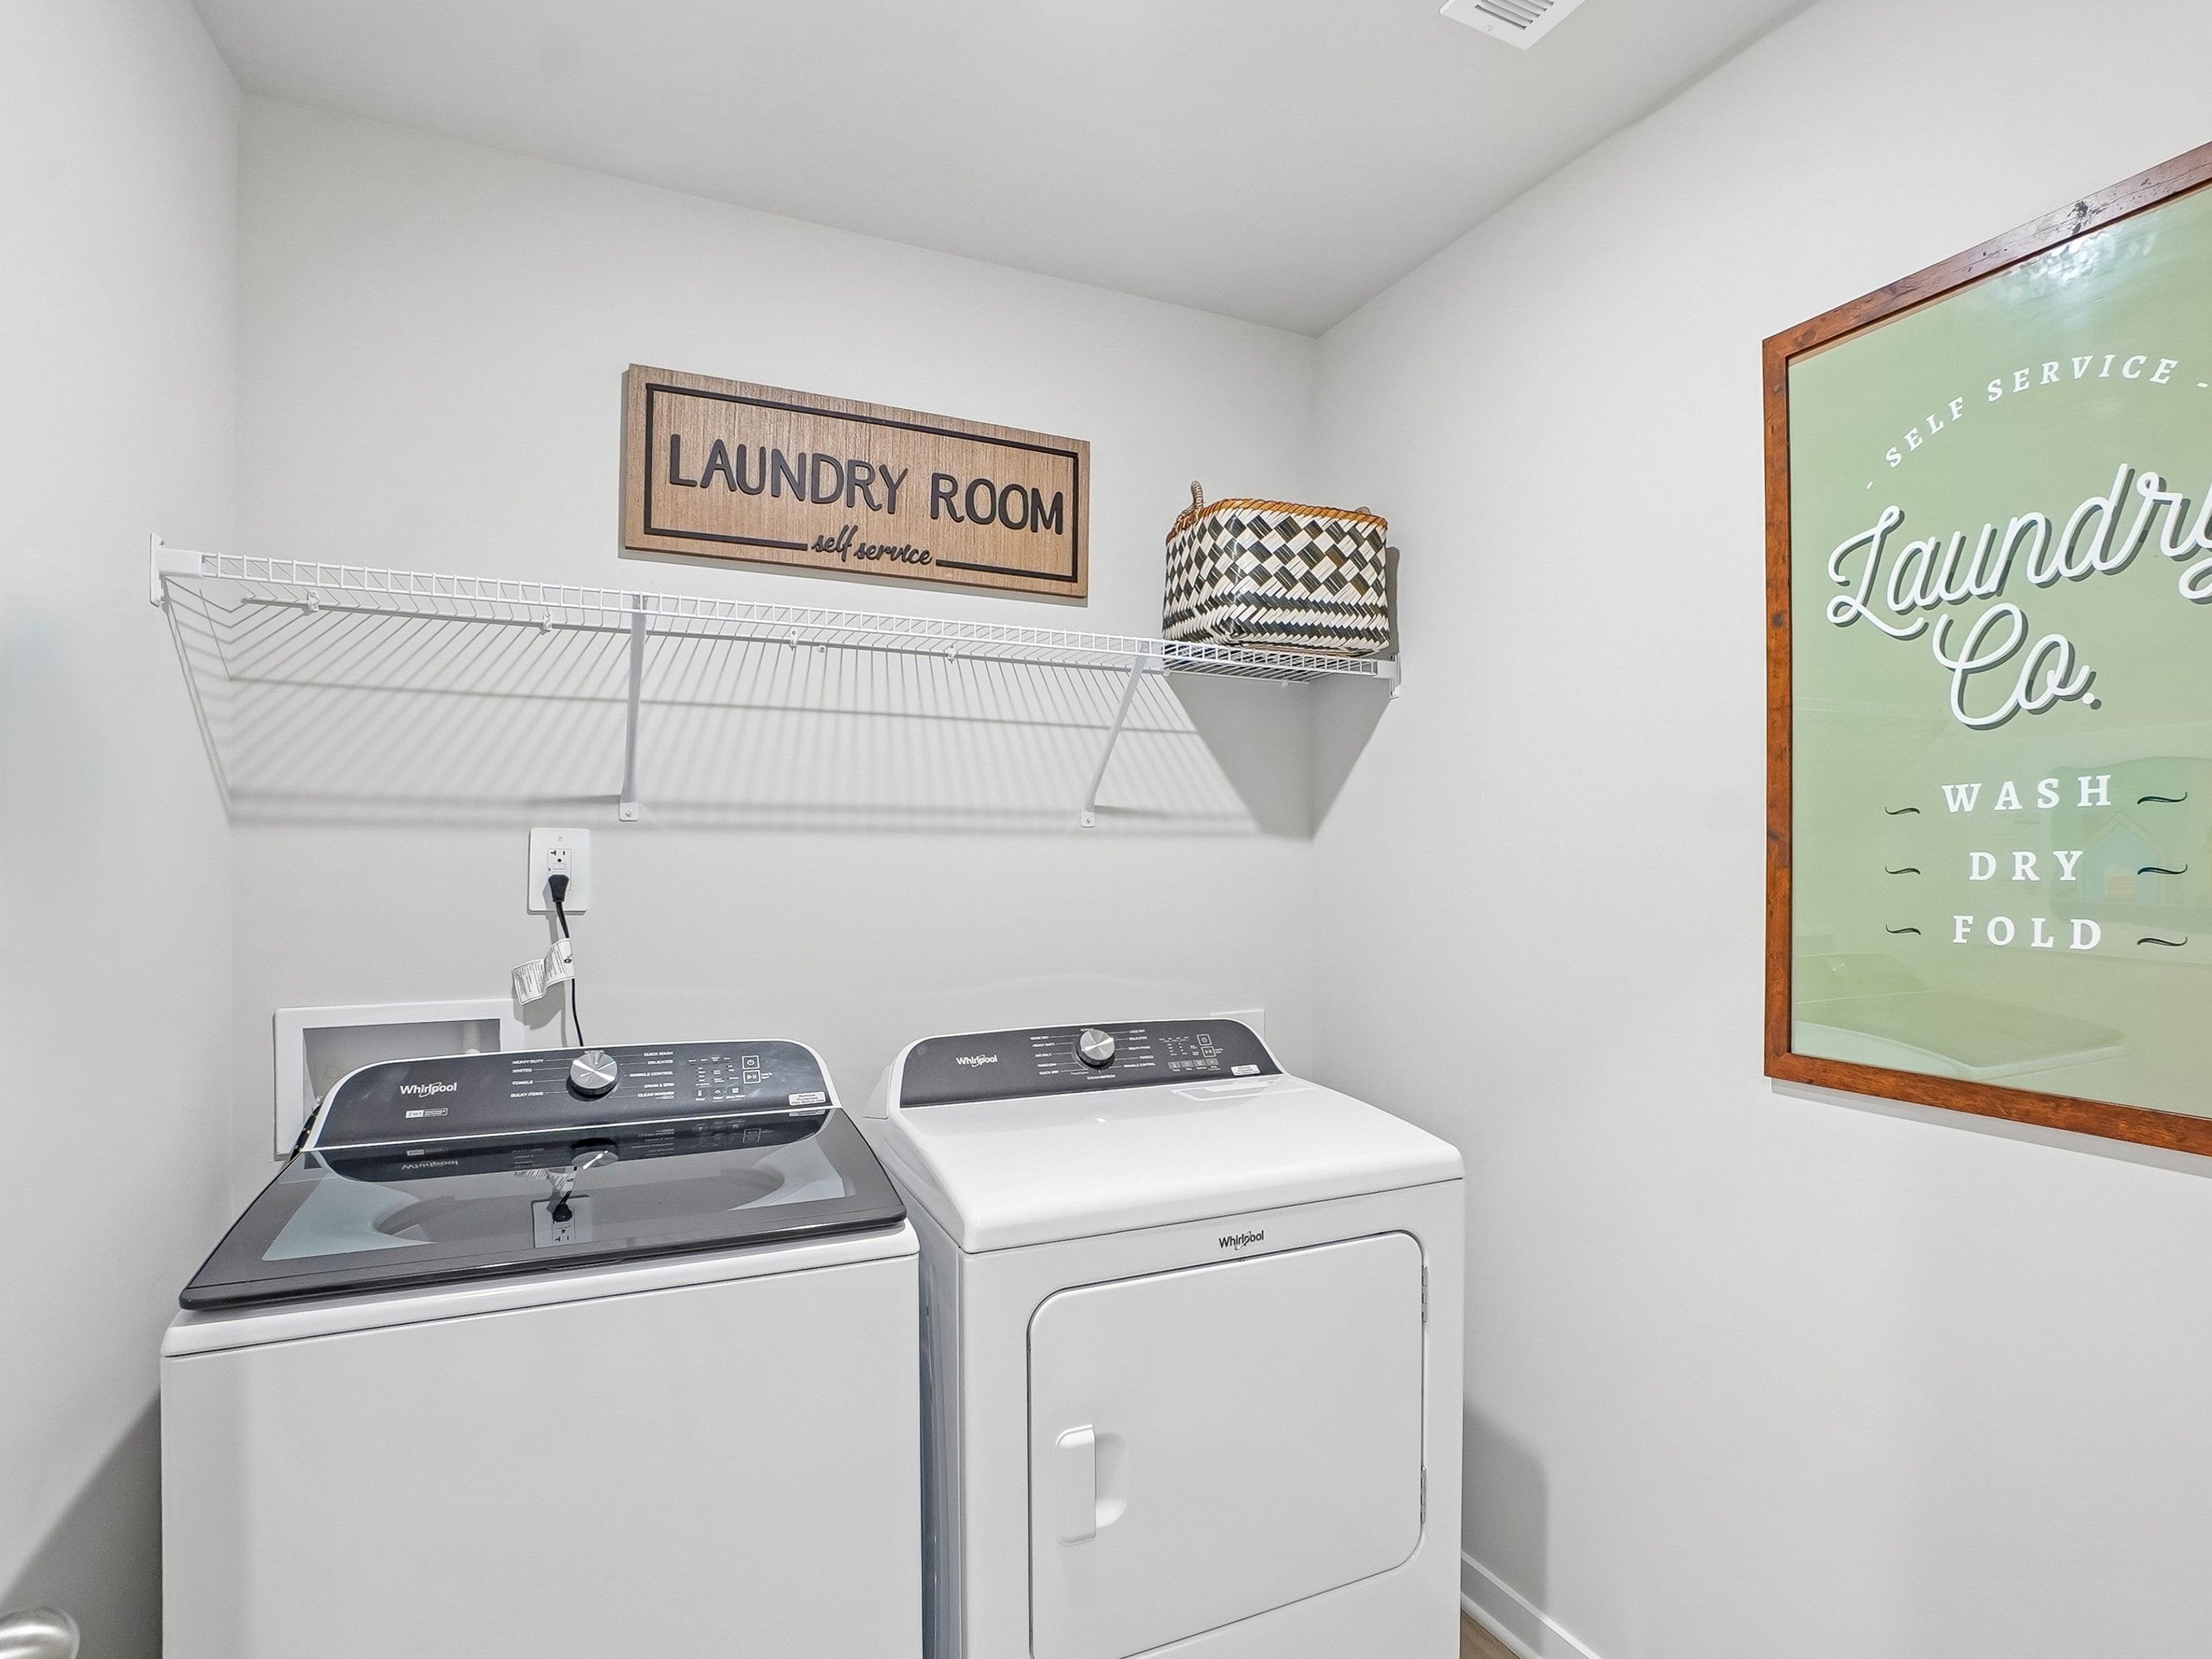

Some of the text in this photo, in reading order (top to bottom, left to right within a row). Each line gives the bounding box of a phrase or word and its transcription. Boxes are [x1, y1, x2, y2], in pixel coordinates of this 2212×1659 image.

[1885, 354, 2179, 468] SELF SERVICE
[669, 433, 1064, 536] LAUNDRY ROOM
[811, 523, 933, 565] self service
[1932, 603, 2102, 731] Co.
[1942, 774, 2112, 813] WASH
[1968, 850, 2083, 882] DRY
[1952, 915, 2102, 951] FOLD
[955, 1053, 998, 1068] Whirlpool
[400, 1082, 458, 1097] Whirlpool
[1218, 1229, 1264, 1251] Whirlpool
